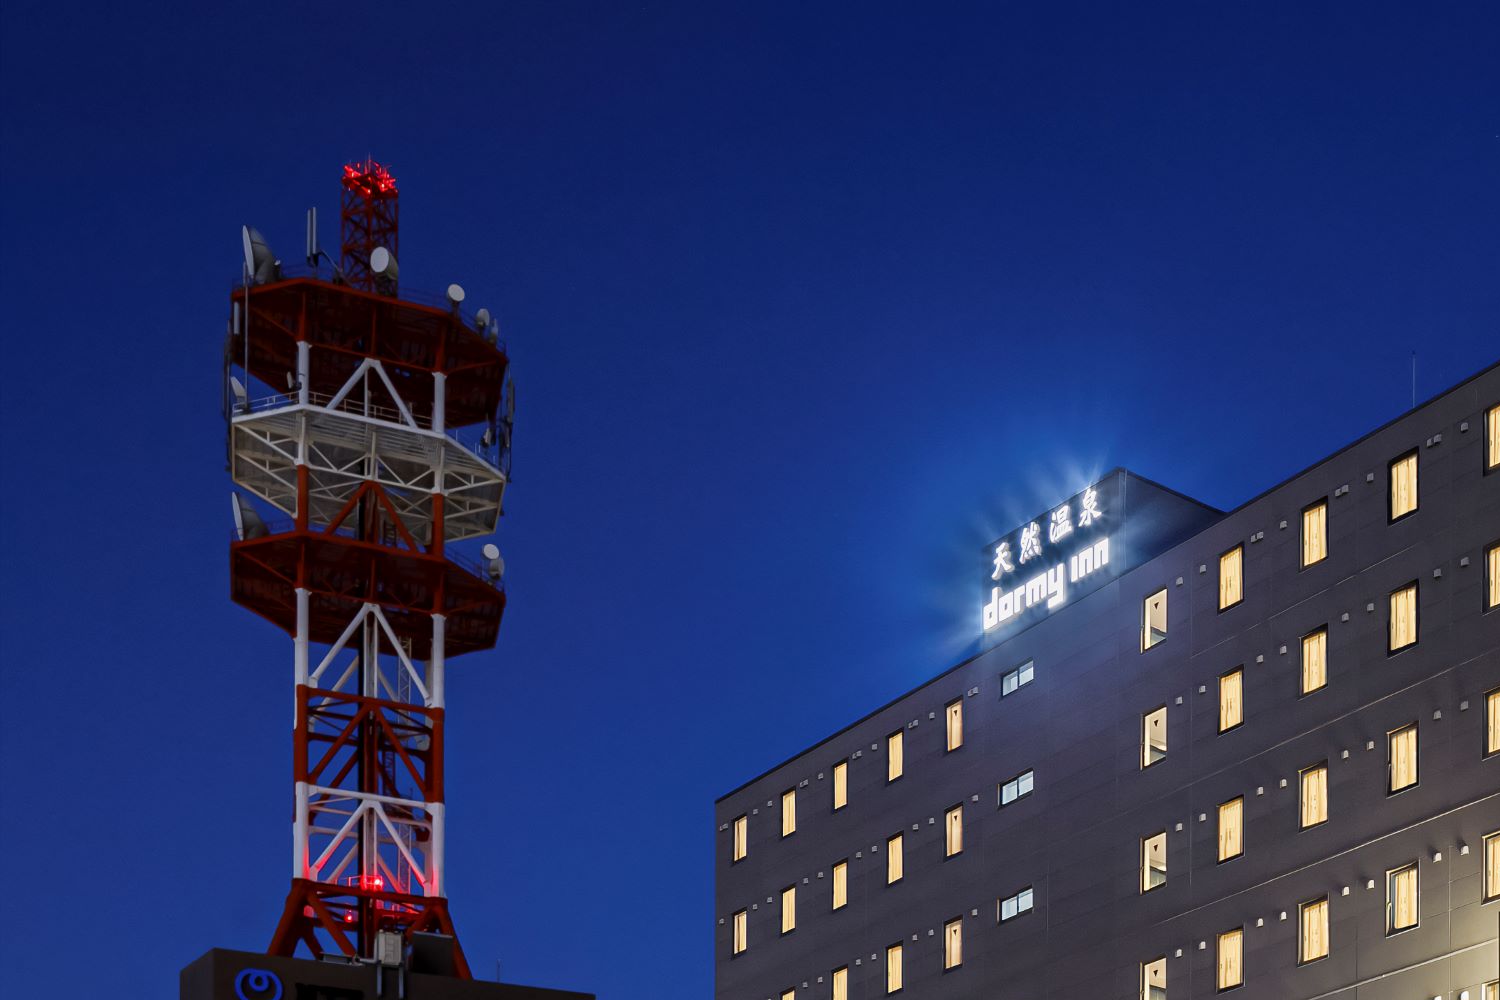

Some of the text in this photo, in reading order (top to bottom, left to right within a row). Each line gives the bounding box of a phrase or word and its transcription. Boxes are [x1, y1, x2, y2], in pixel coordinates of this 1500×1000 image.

[991, 488, 1103, 580] 天然温泉
[983, 537, 1110, 630] dormy inn
